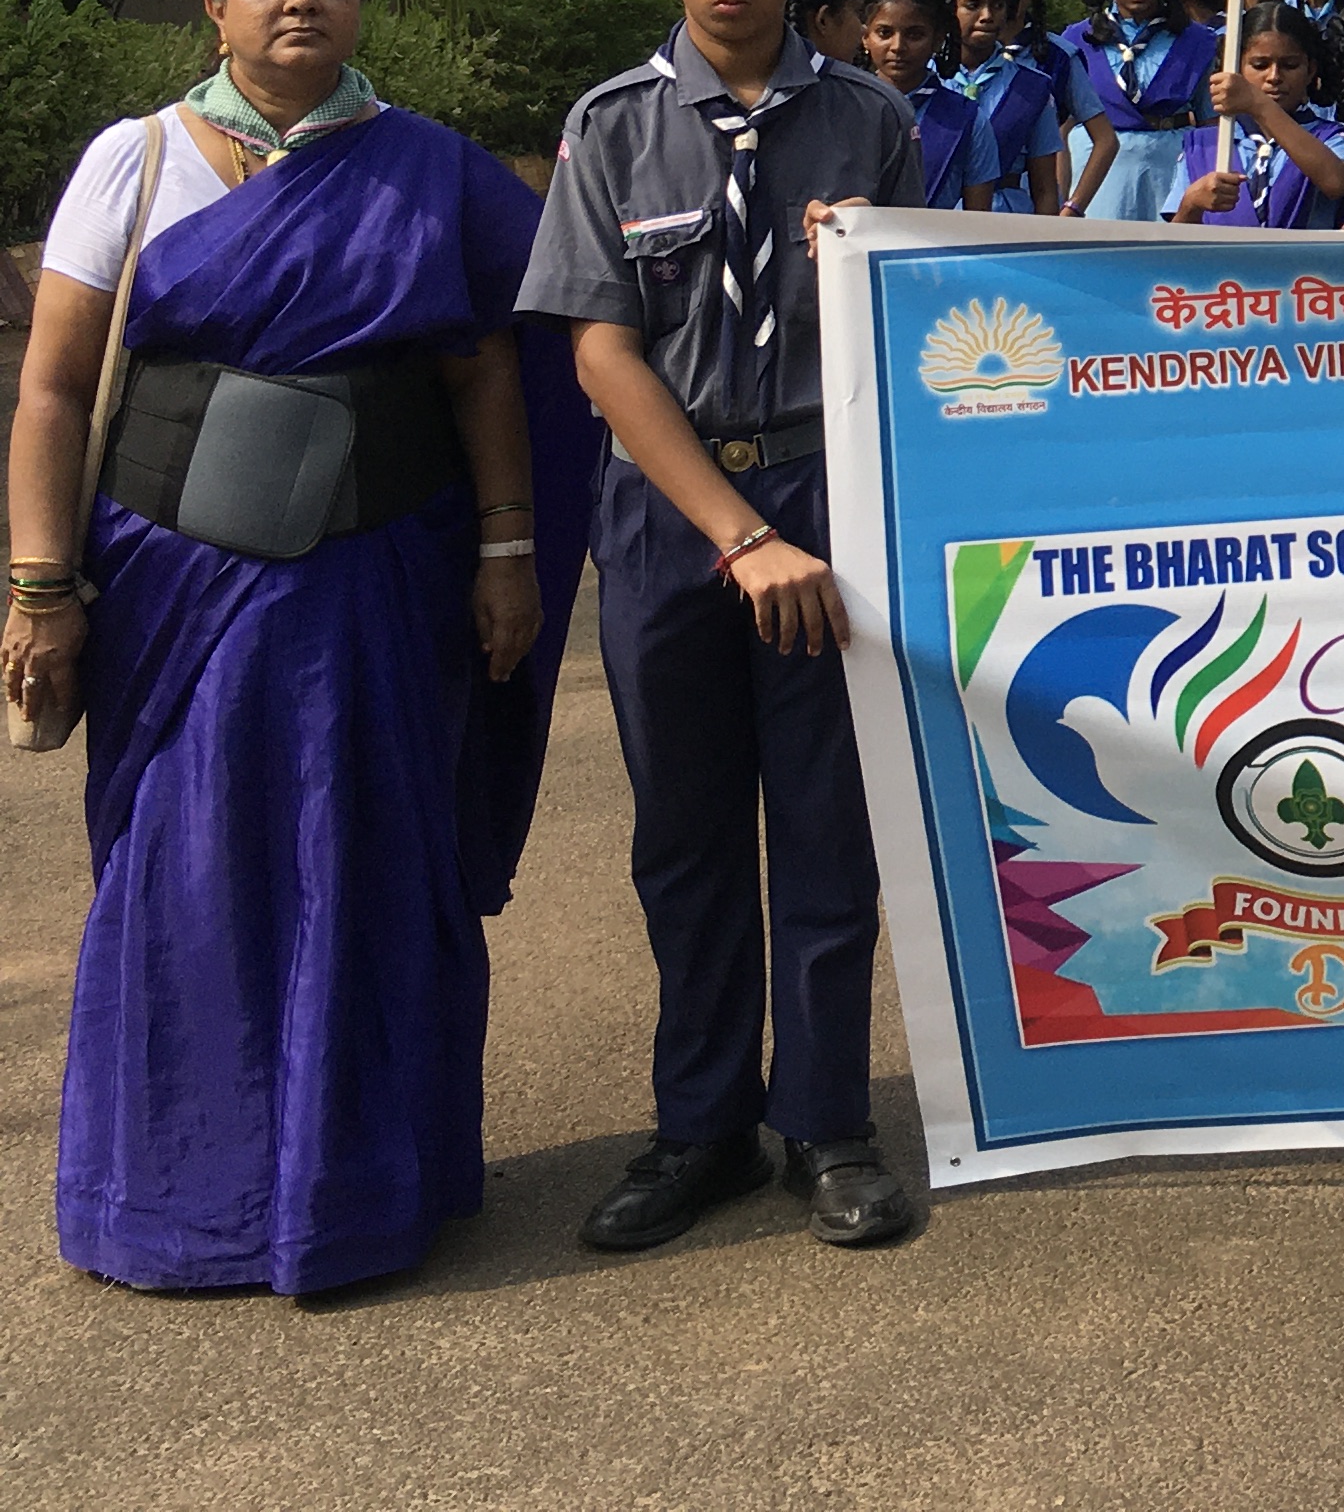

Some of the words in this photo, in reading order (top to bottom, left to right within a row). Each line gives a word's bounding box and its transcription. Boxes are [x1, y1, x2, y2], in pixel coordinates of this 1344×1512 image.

[1152, 281, 1282, 331] केंद्रीय
[1069, 347, 1288, 394] KENDRIYA
[1032, 544, 1116, 598] THE
[1124, 532, 1297, 591] BHARAT
